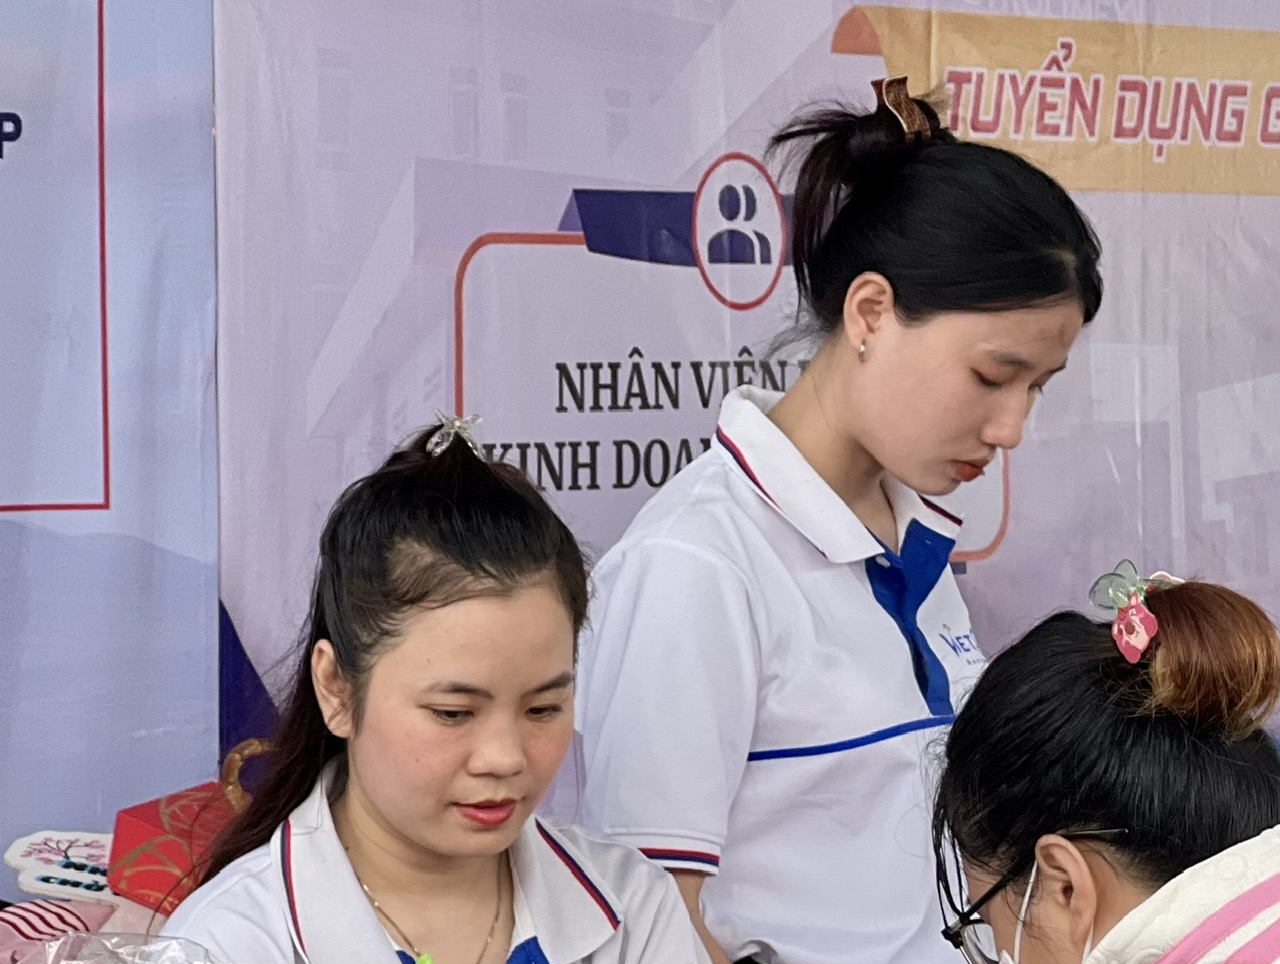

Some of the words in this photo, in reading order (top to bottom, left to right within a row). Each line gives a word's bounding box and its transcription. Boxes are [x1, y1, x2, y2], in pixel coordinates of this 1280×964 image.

[945, 38, 1102, 141] TUYỂN
[1112, 74, 1253, 163] DỤNG
[555, 346, 682, 413] NHÂN
[690, 345, 787, 410] VIÊN
[612, 438, 712, 490] DOA
